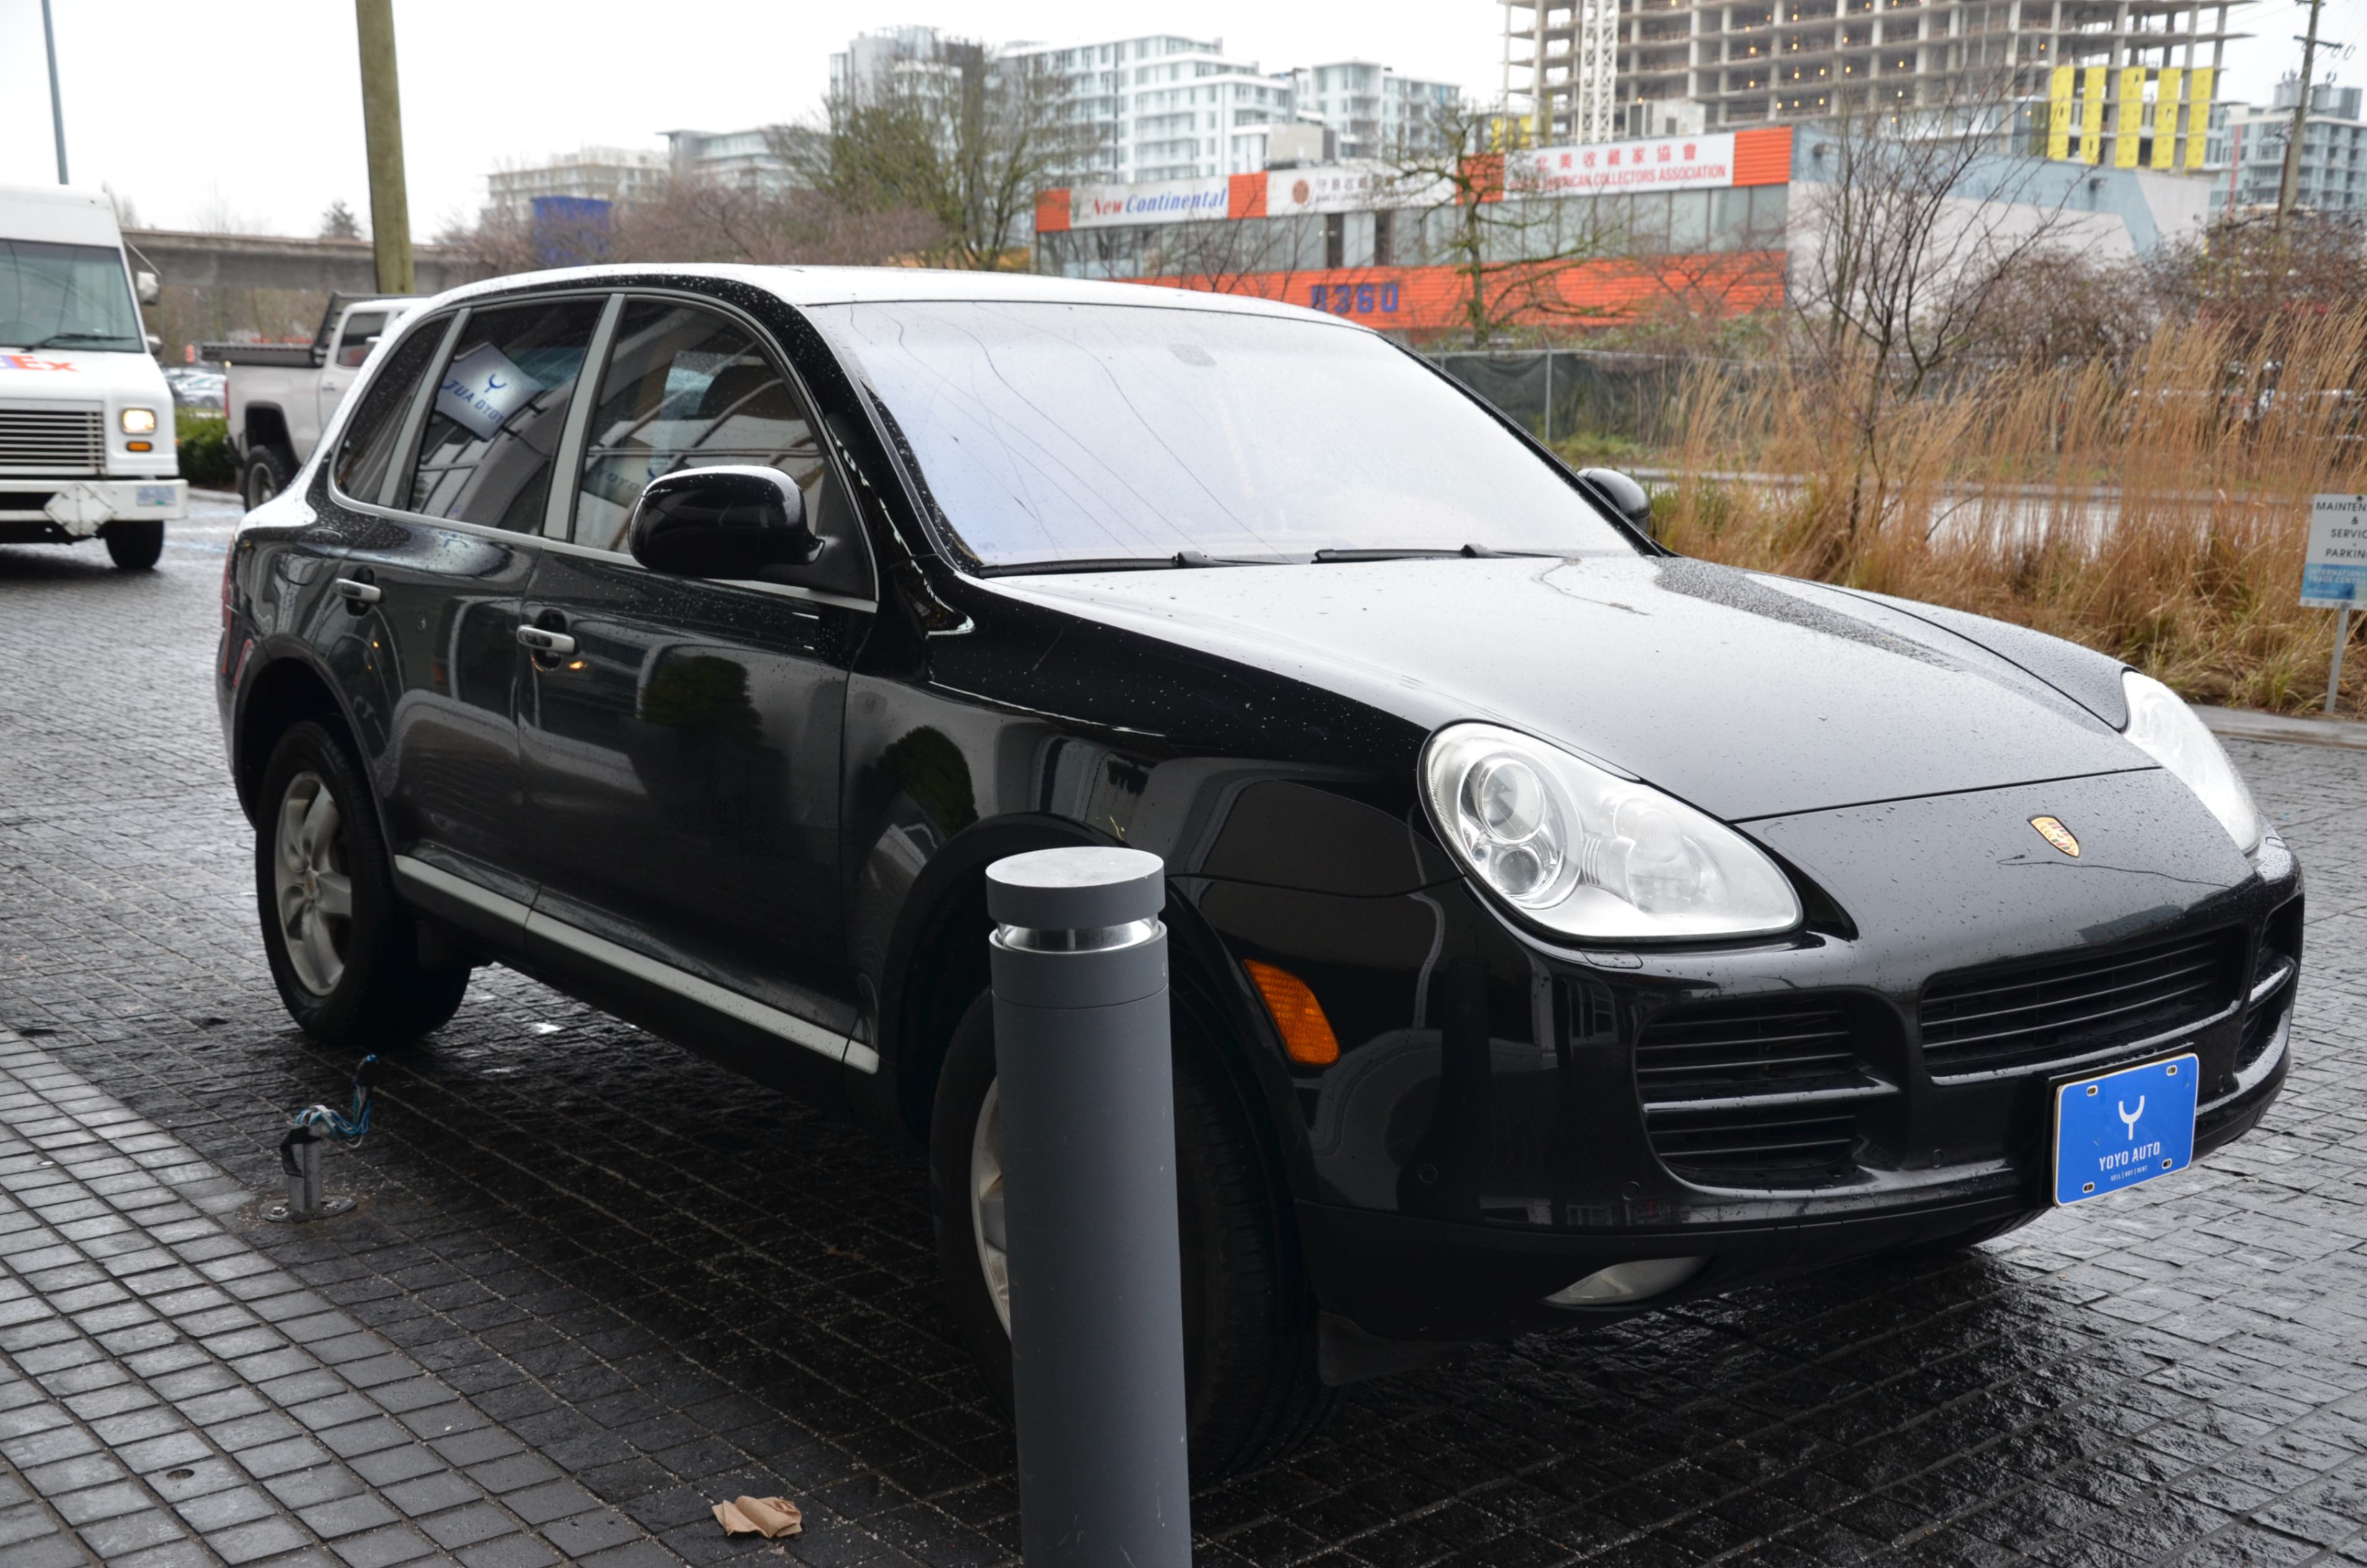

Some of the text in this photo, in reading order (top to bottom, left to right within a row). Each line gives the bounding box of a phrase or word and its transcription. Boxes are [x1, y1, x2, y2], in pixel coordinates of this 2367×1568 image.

[1595, 168, 1656, 186] COLLECTORS
[1659, 163, 1725, 181] ASSOCIATION
[1092, 188, 1226, 215] New Continental
[1311, 283, 1398, 314] 8360
[2316, 502, 2367, 511] MAINTEN
[2351, 516, 2358, 525] &
[2325, 549, 2367, 558] PARKIN
[2099, 1141, 2160, 1172] YOYO AUTO
